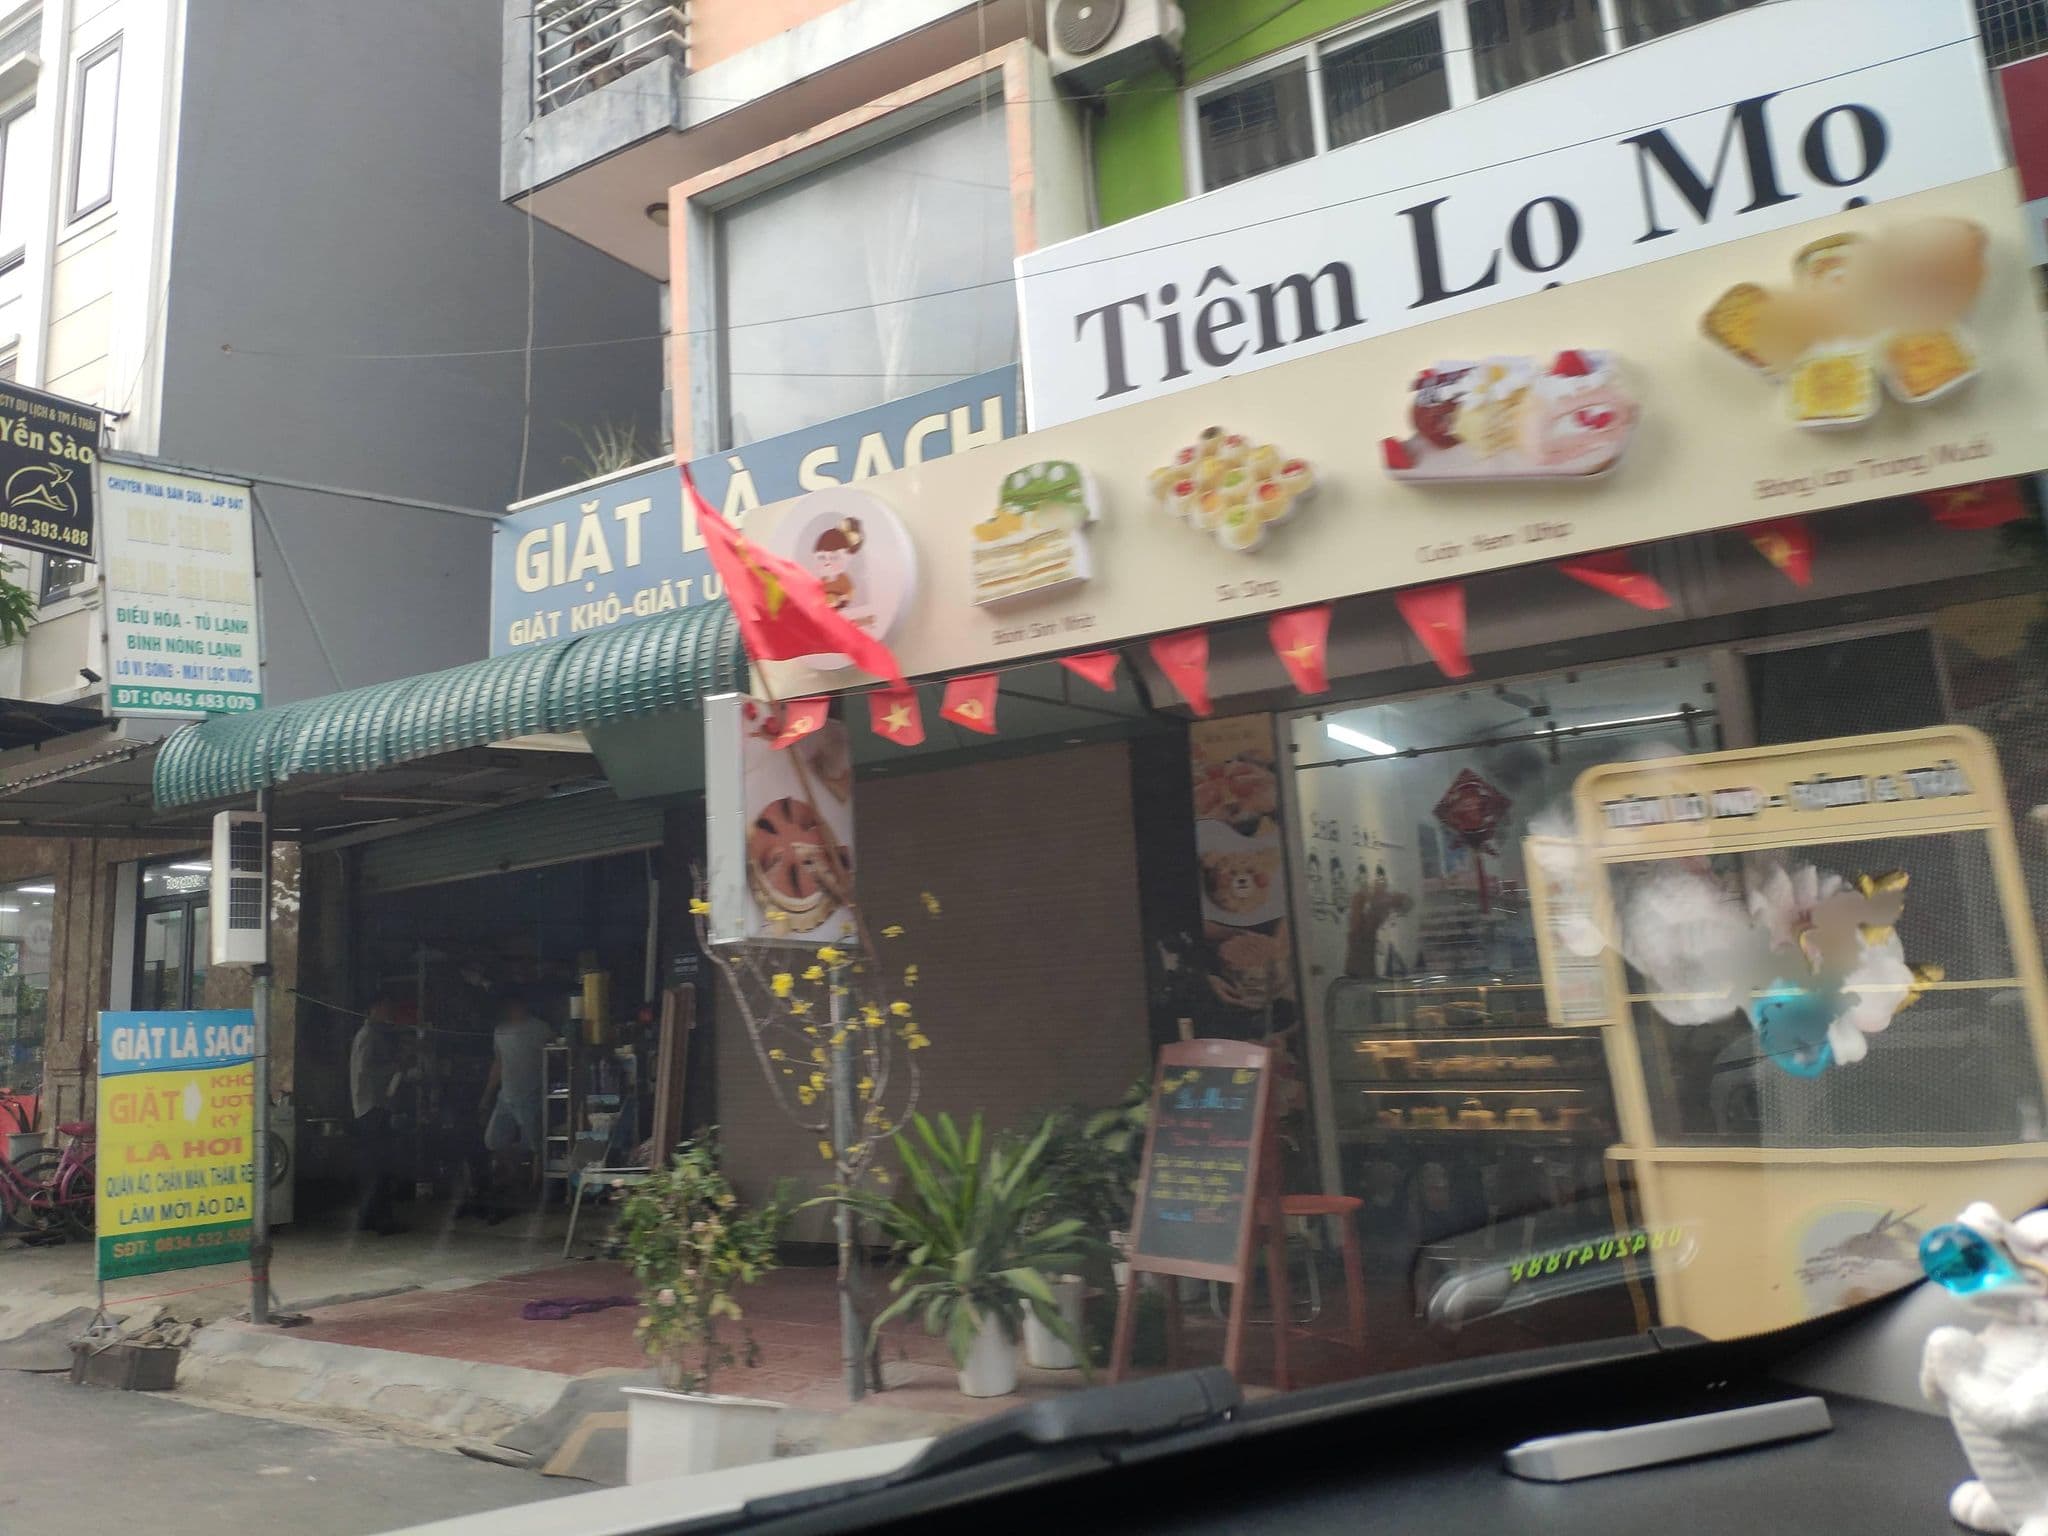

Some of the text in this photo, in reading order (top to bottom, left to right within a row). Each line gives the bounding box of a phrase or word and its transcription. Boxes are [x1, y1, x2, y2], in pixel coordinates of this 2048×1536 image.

[1396, 194, 1583, 309] Lọ
[1621, 92, 1891, 244] Mọ
[0, 416, 94, 465] Yến Sào
[514, 497, 652, 593] GIẶT
[111, 1022, 166, 1067] GIẶT
[170, 1021, 199, 1058] LÀ
[224, 1196, 247, 1213] DA
